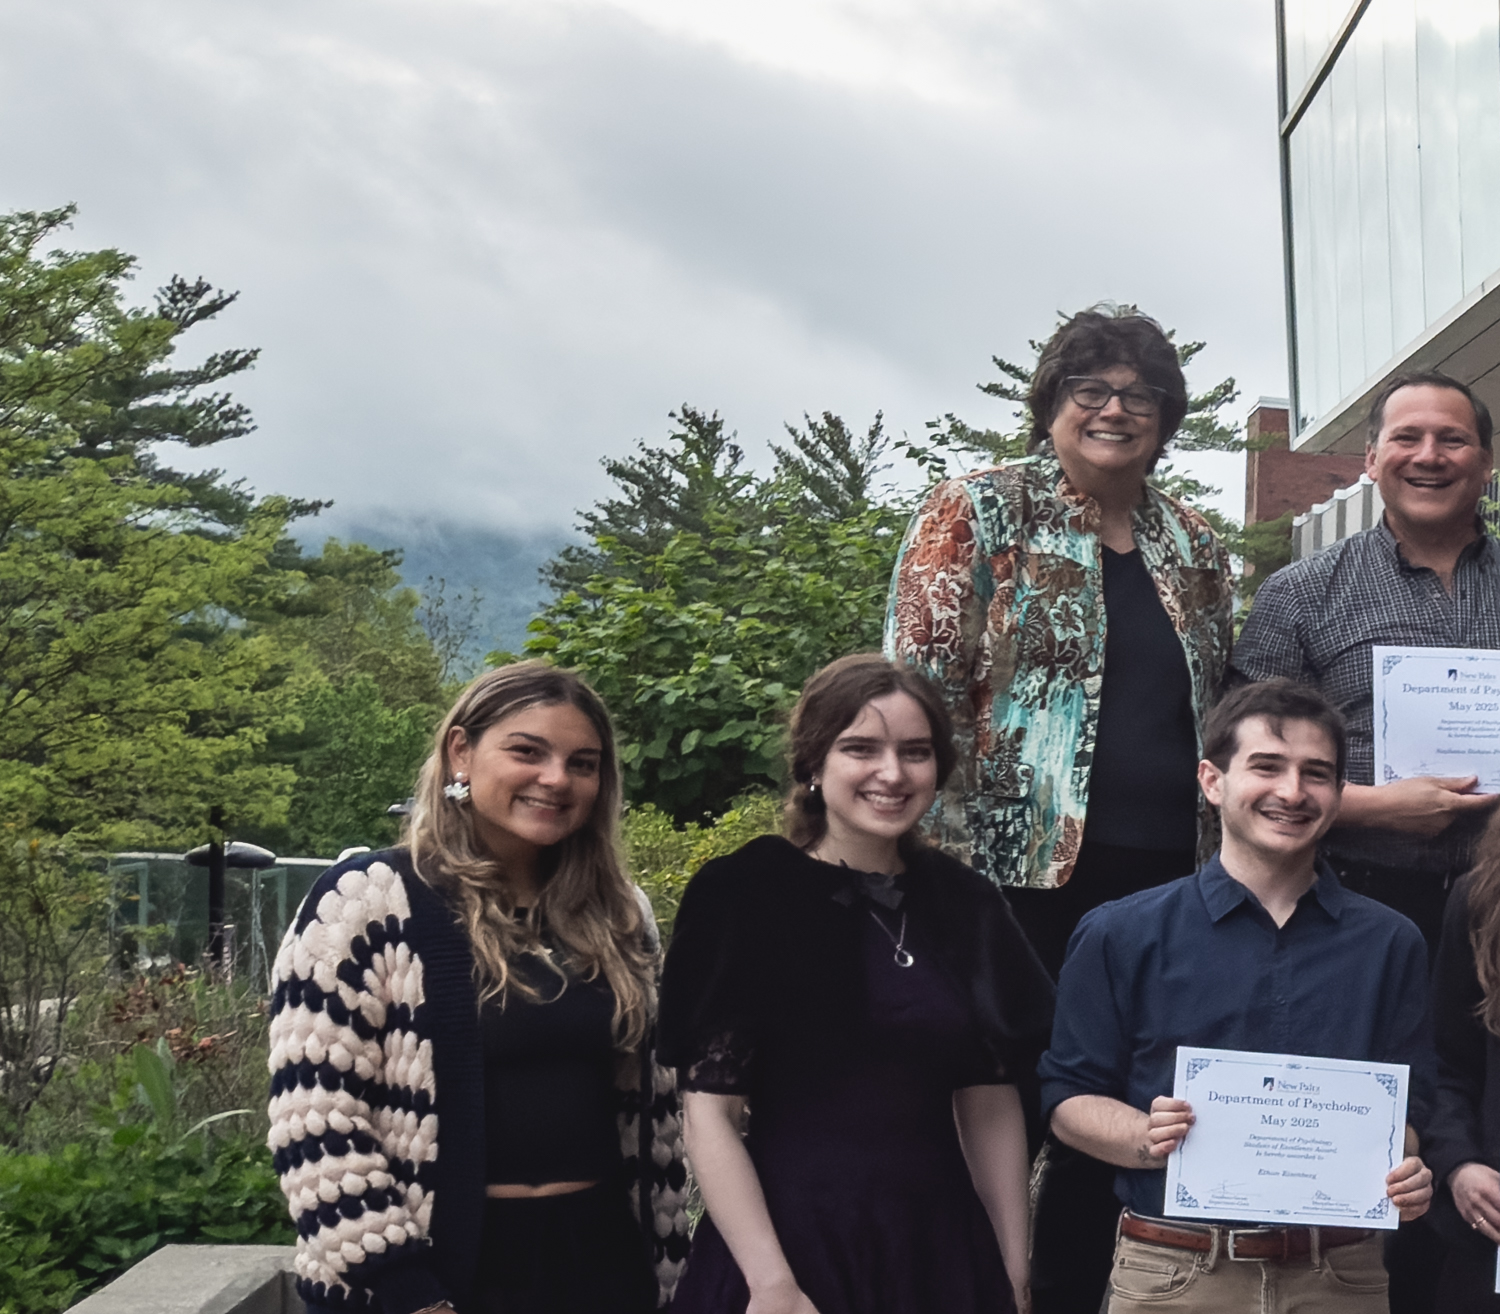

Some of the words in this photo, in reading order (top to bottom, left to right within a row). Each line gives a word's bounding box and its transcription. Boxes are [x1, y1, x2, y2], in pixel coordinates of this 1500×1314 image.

[1402, 682, 1467, 694] Department
[1469, 684, 1480, 694] of
[1448, 701, 1472, 713] May
[1474, 702, 1499, 712] 2025
[1277, 1080, 1297, 1090] New
[1208, 1090, 1283, 1106] Department
[1287, 1097, 1301, 1107] of
[1303, 1097, 1371, 1115] Psychology
[1260, 1114, 1287, 1127] May
[1290, 1116, 1319, 1128] 2025
